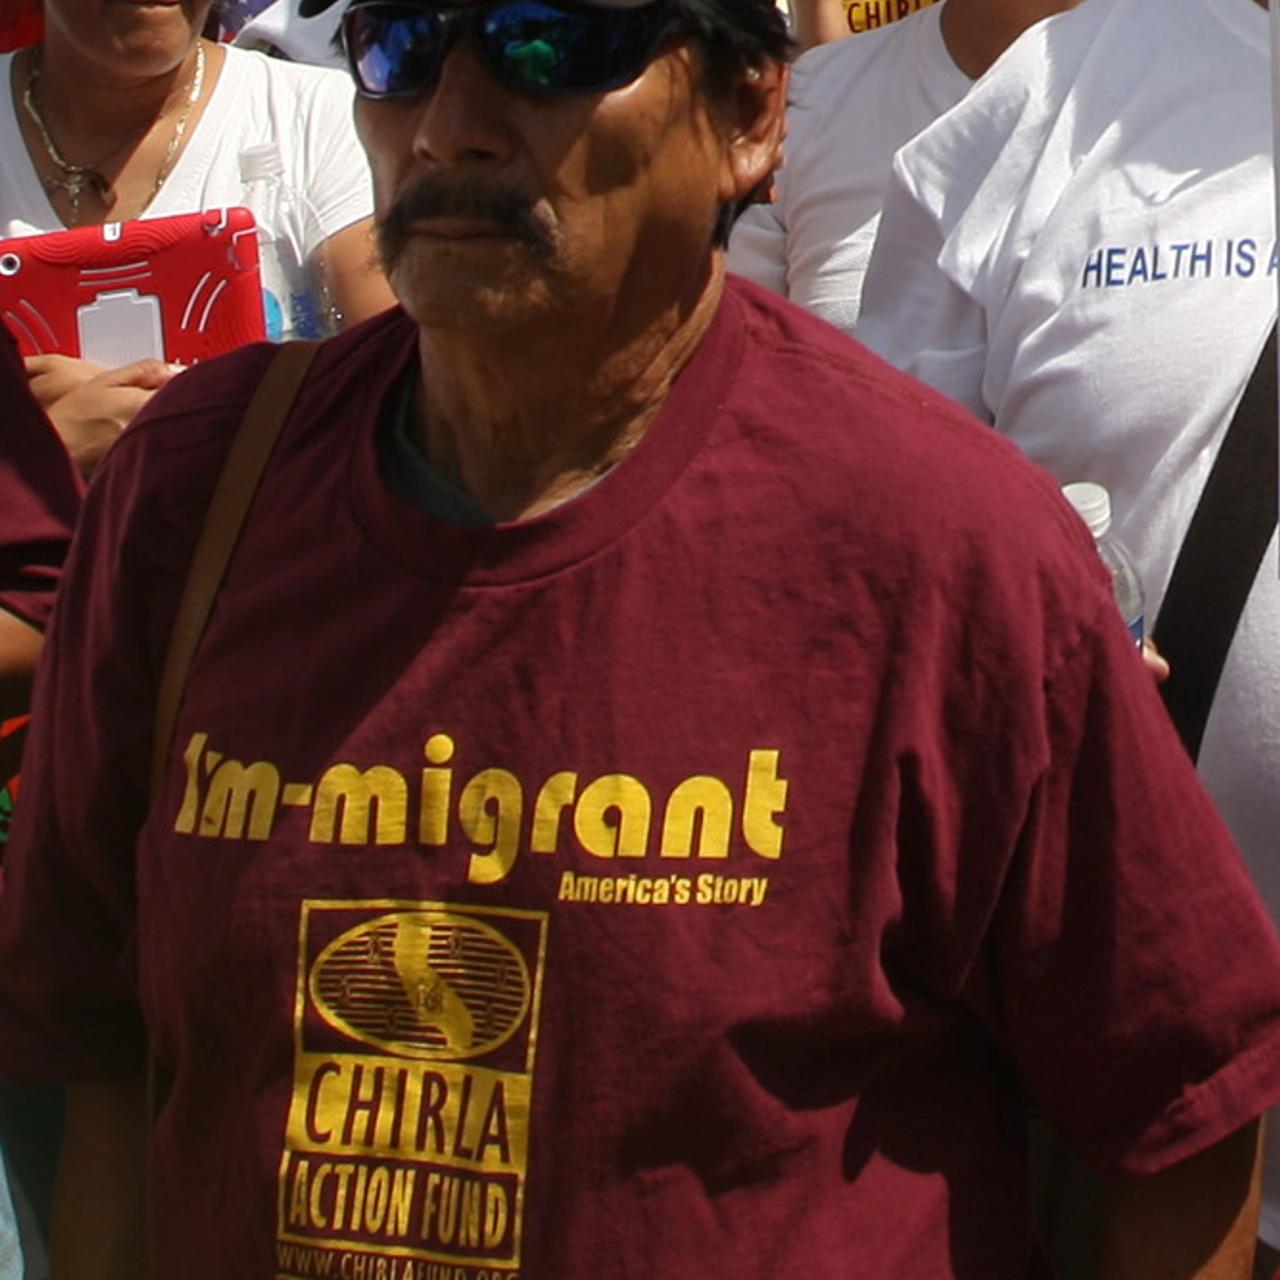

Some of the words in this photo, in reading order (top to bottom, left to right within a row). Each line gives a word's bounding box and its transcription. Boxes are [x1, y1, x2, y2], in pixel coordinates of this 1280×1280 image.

[1081, 239, 1213, 288] HEALTH
[1225, 239, 1257, 279] IS
[558, 871, 691, 904] America's
[695, 875, 769, 906] Story
[305, 1061, 511, 1164] CHIRLA
[289, 1159, 416, 1237] ACTION
[421, 1172, 508, 1249] FUND
